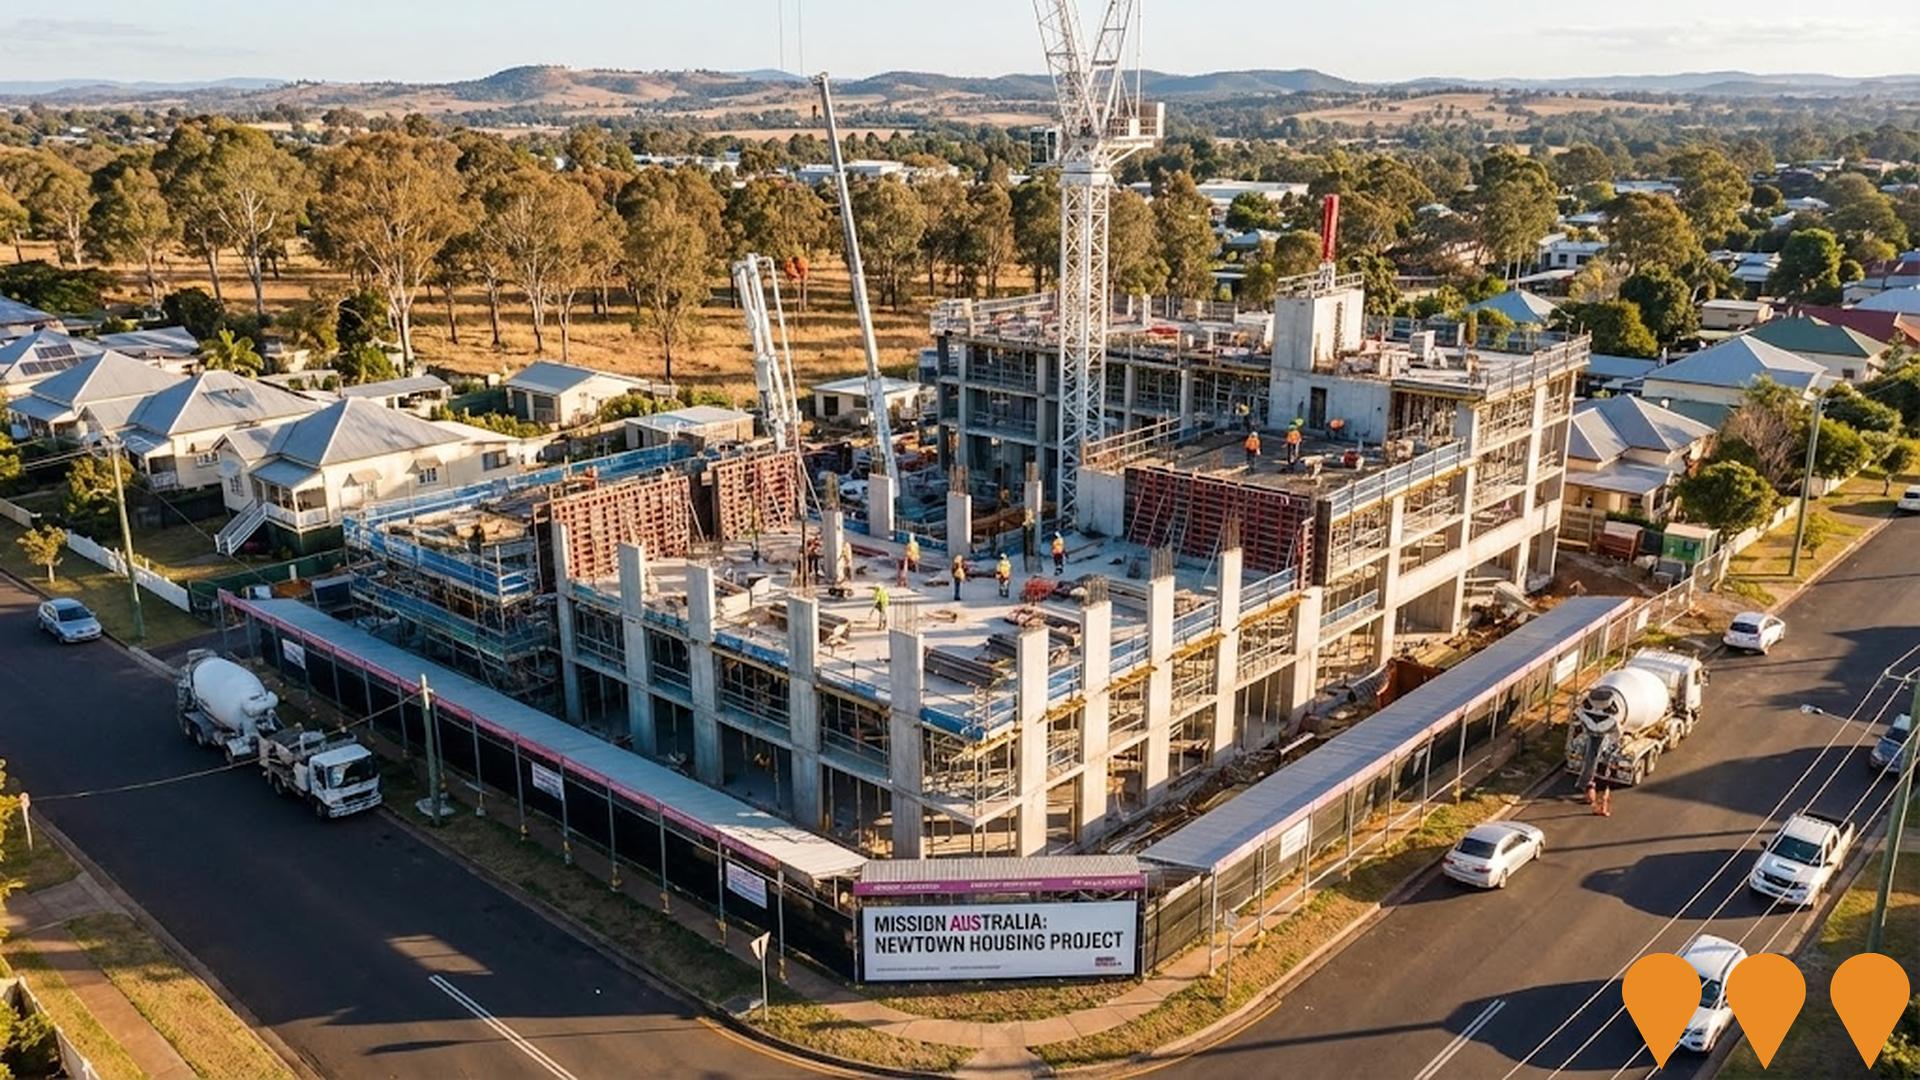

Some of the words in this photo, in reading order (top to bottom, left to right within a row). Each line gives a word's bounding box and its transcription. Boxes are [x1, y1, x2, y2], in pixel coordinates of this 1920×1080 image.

[875, 915, 946, 932] MISSION
[950, 913, 1047, 931] AUSTRALIA:
[875, 935, 965, 953] NEWTOWN
[970, 934, 1045, 951] HOUSING
[1050, 931, 1124, 950] PROJECT
